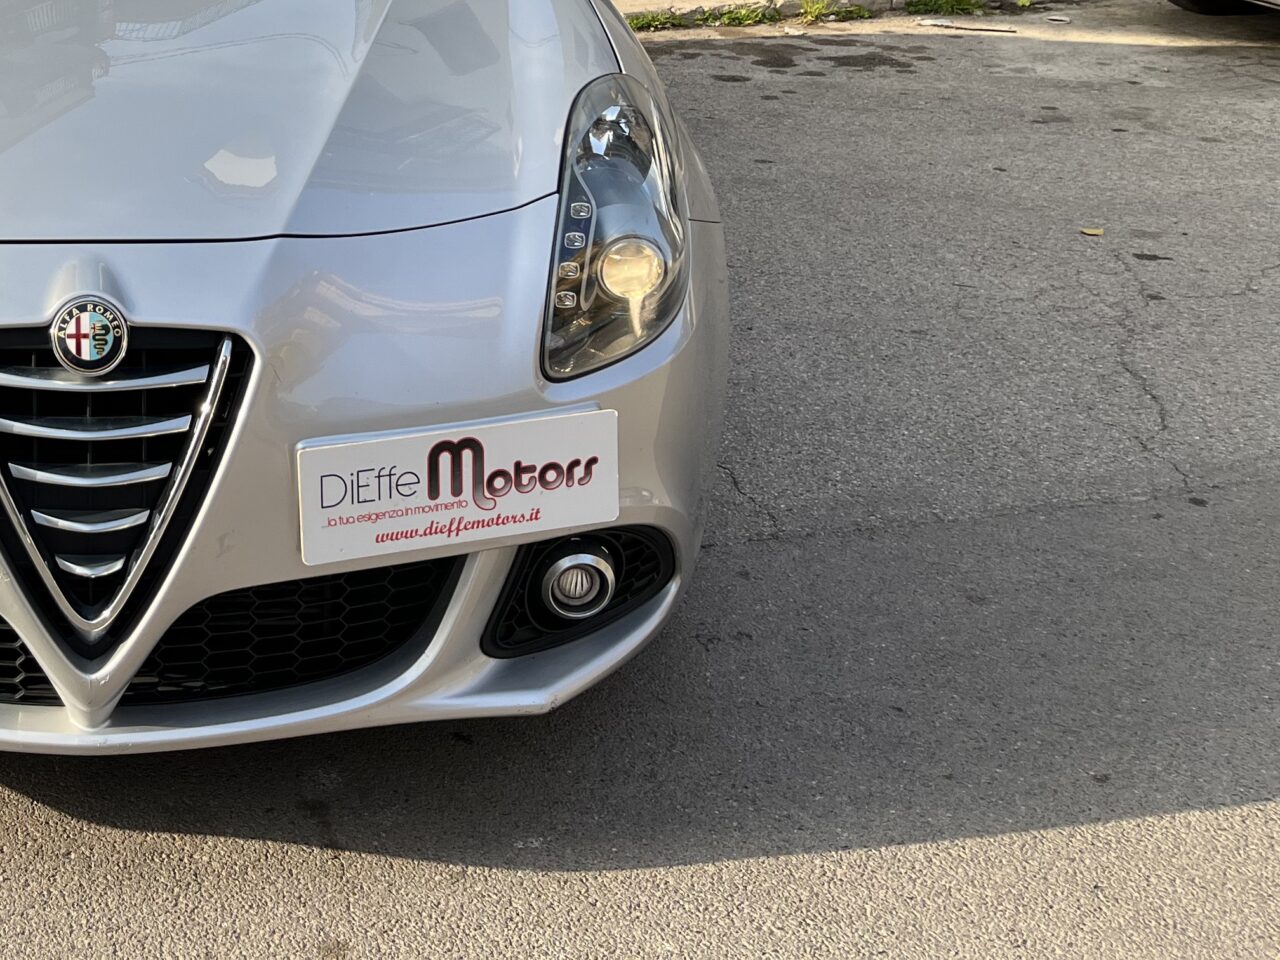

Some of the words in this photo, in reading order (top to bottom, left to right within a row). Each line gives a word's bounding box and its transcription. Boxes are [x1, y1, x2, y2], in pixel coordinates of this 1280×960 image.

[57, 308, 80, 338] ALFA
[86, 303, 122, 337] ROMEO
[321, 466, 420, 509] DiEffe
[427, 436, 599, 511] Motors
[339, 515, 355, 526] tua
[414, 500, 468, 515] movimento
[375, 508, 541, 544] www.dieffemotors.it
